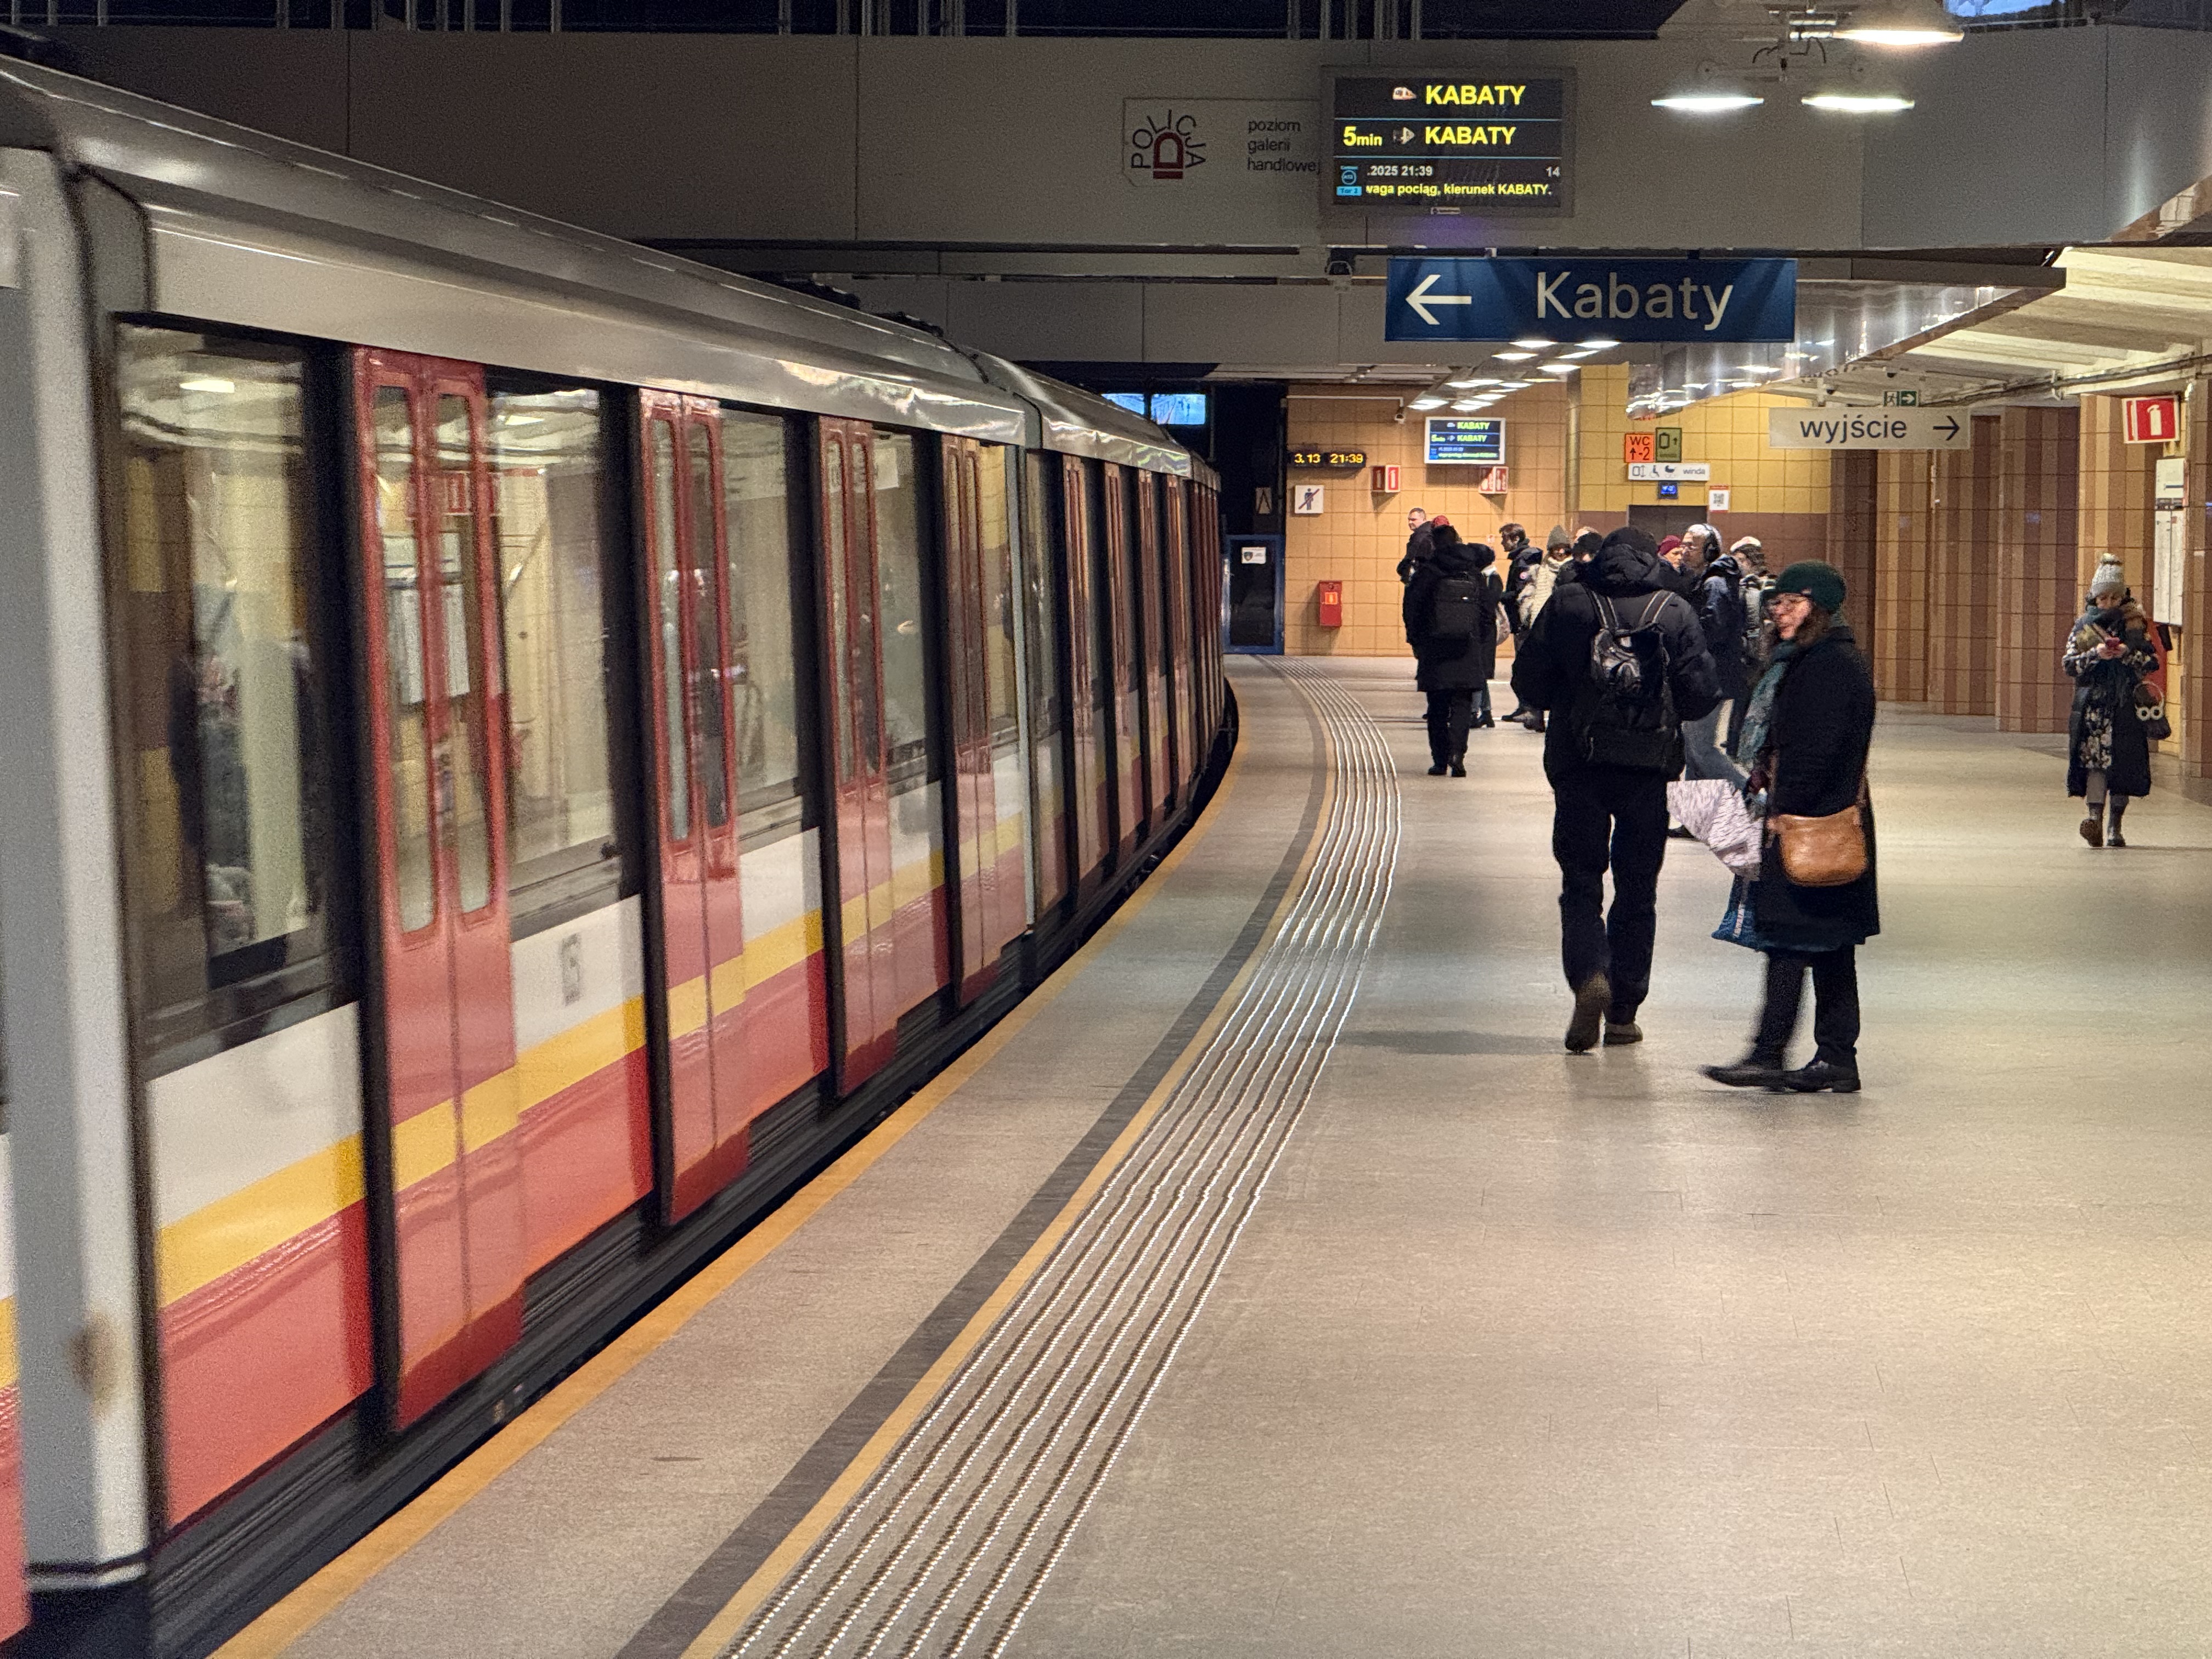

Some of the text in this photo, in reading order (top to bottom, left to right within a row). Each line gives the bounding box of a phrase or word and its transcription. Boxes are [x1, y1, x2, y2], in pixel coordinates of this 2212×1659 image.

[1426, 85, 1526, 105] KABATY
[1248, 118, 1301, 134] poziom
[1131, 109, 1206, 168] POLICJA
[1343, 126, 1517, 146] 5min KABATY
[1247, 138, 1290, 154] galerii
[1246, 157, 1321, 175] handlowej
[1401, 166, 1433, 176] 21:39
[1546, 166, 1560, 177] 14
[1443, 184, 1495, 195] kierunek
[1498, 184, 1552, 195] KABATY.
[1537, 272, 1734, 330] Kabaty
[1800, 414, 1907, 444] wyjście
[1629, 436, 1651, 445] WC
[1639, 447, 1650, 460] -2
